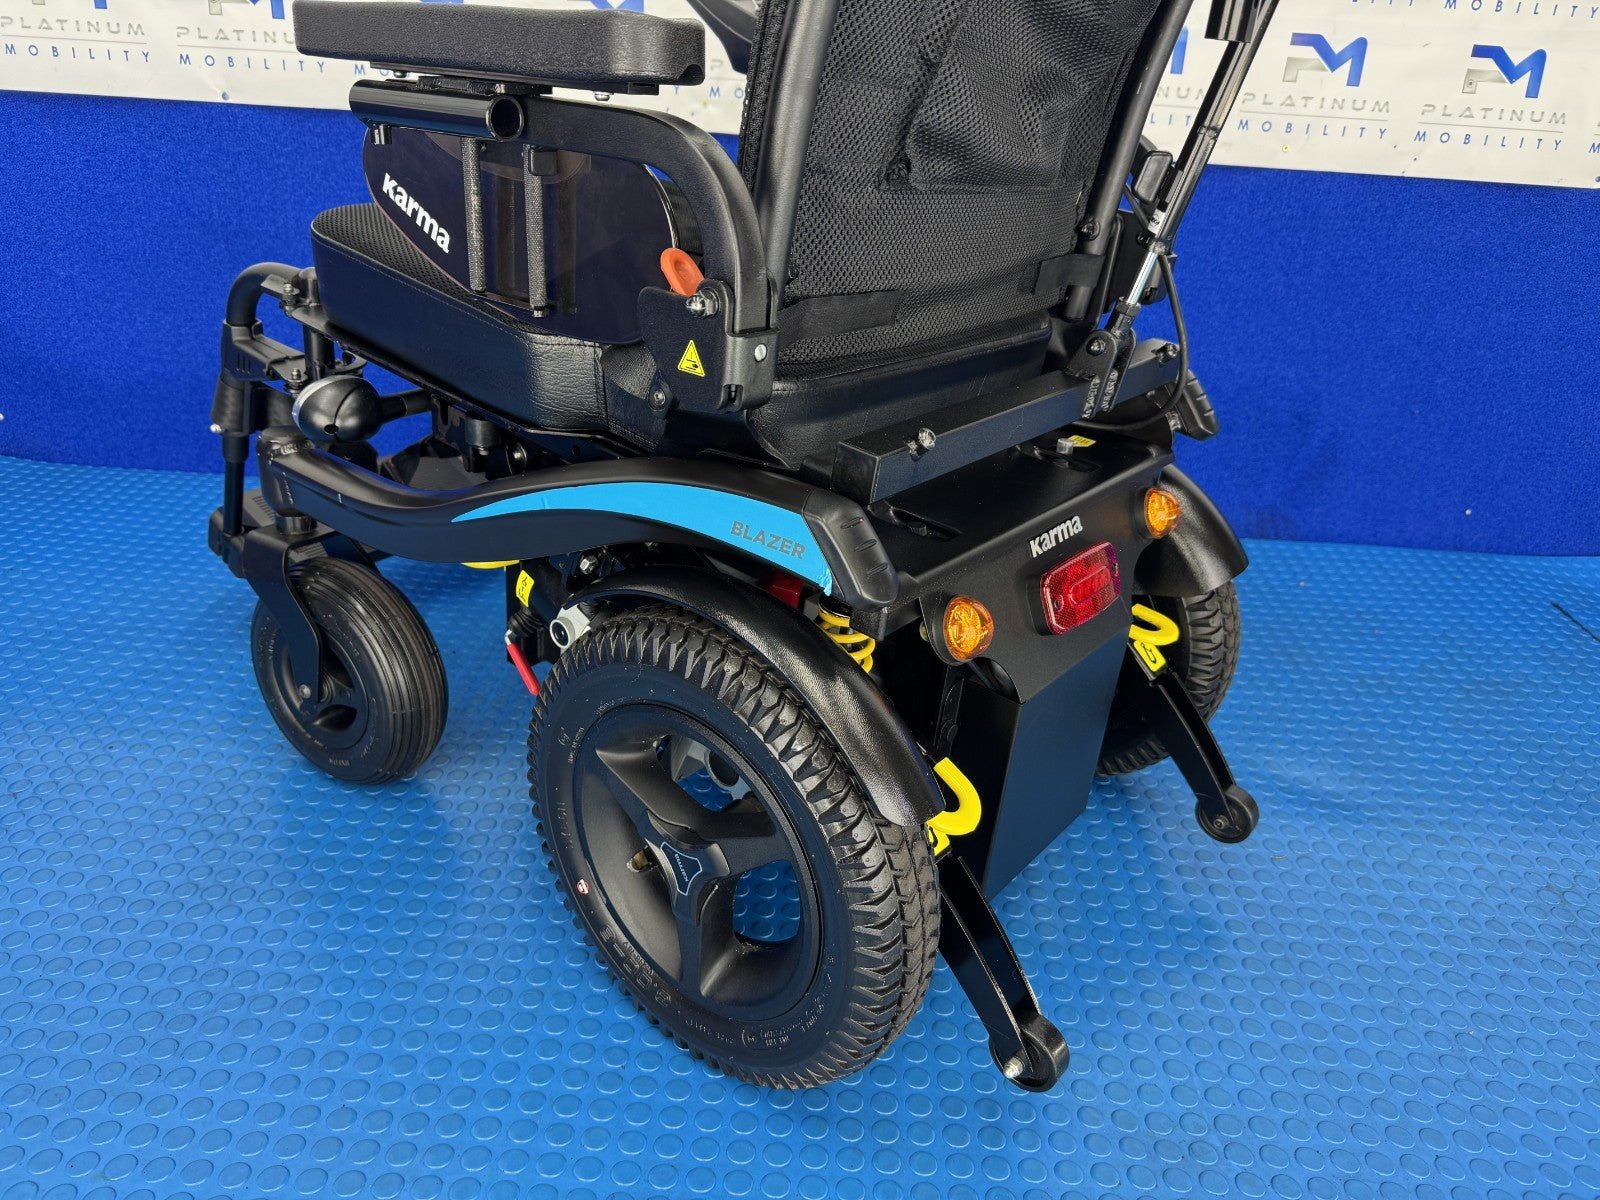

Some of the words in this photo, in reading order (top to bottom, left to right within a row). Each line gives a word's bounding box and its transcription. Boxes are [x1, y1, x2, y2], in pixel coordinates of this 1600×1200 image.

[1444, 0, 1599, 18] MOBILITY
[0, 15, 145, 36] PLATINUM
[176, 26, 296, 44] PLATINU
[5, 43, 149, 62] MOBILITY
[179, 53, 325, 73] MOBILITY
[1241, 92, 1390, 114] PLATINUM
[1420, 103, 1567, 125] PLATINUM
[1238, 119, 1387, 139] MOBILITY
[1413, 130, 1562, 151] MOBILITY
[382, 172, 450, 254] karma
[731, 520, 806, 560] BLAZER
